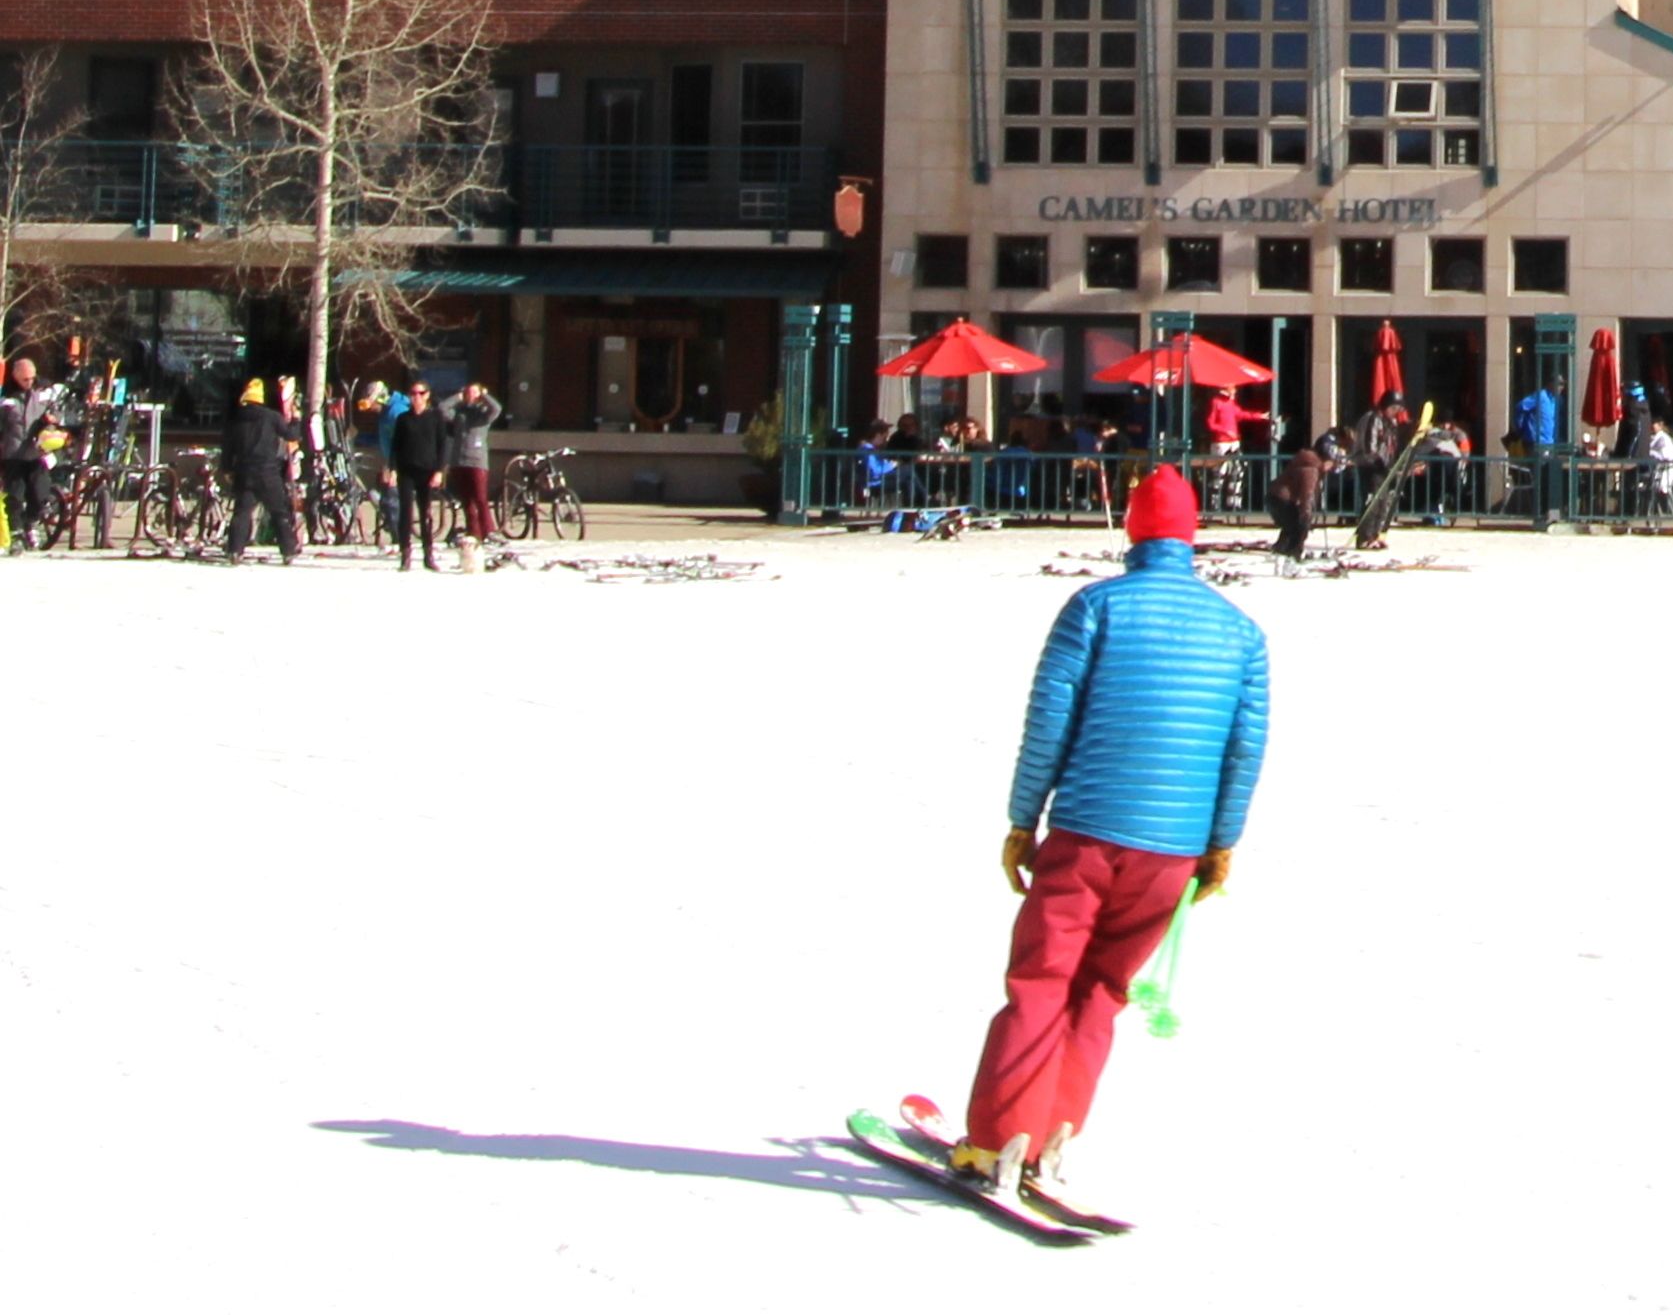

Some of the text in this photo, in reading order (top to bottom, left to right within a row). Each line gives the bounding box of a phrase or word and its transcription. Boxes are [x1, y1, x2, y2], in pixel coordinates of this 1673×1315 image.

[1038, 196, 1442, 223] CAMEL'S GARDEN HOTEL
